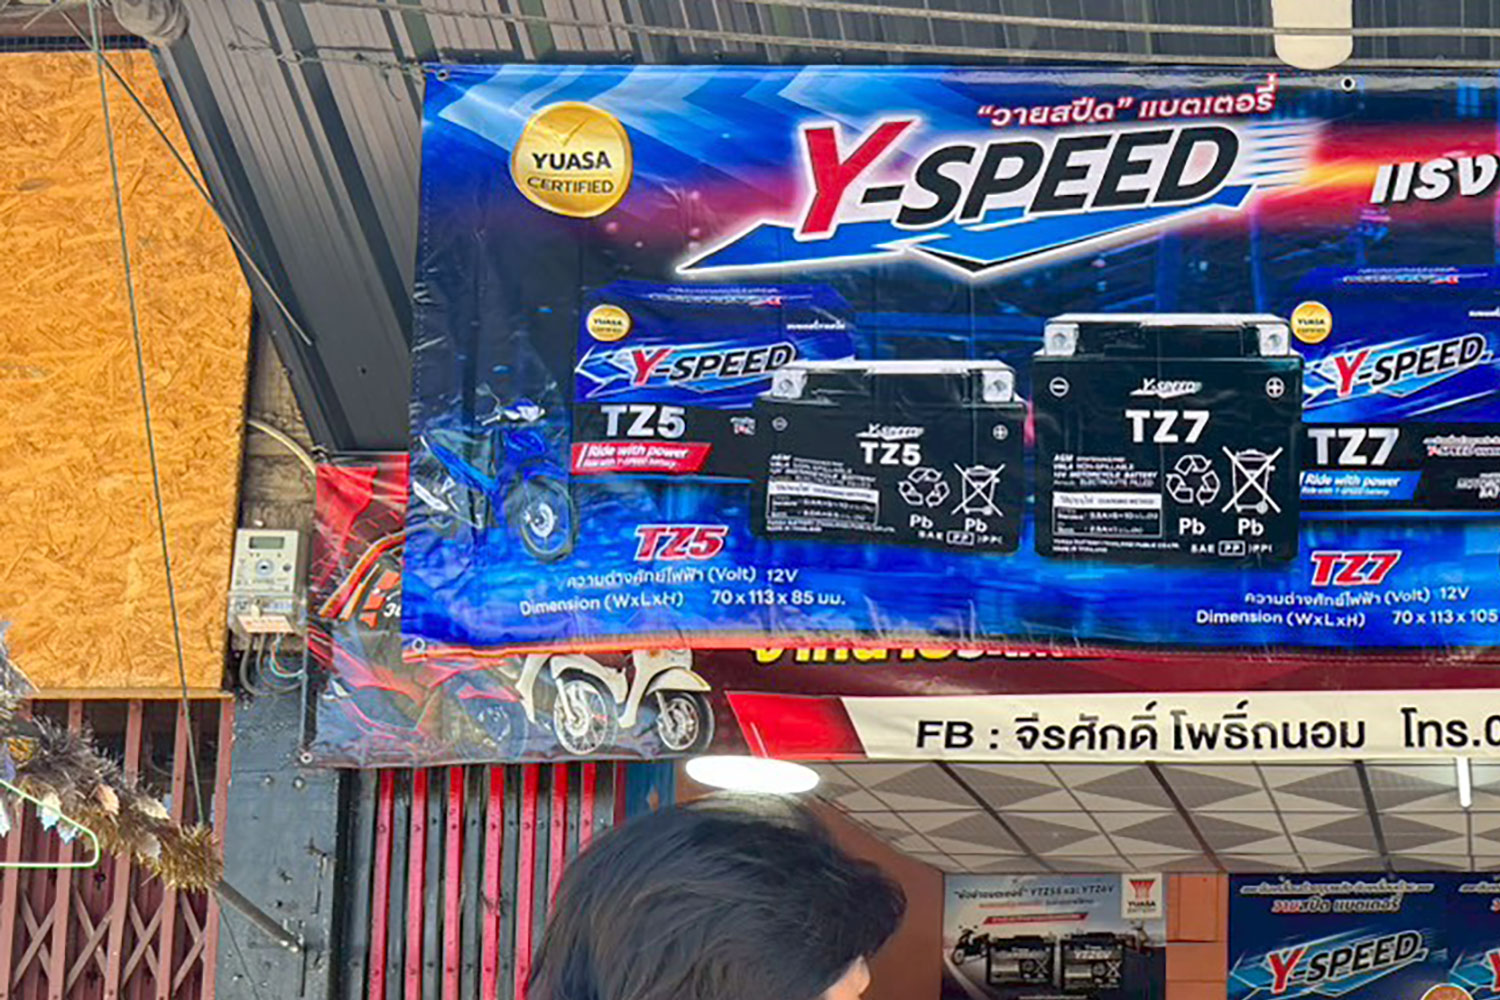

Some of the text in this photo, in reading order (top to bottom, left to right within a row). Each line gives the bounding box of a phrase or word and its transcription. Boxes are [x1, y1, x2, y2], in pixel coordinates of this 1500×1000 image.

[1139, 73, 1279, 120] แบตเตอรี่
[531, 150, 613, 171] YUASA
[527, 176, 615, 196] CERTIFIED
[801, 118, 1240, 235] Y-SPEED
[1370, 152, 1500, 204] แรง
[631, 345, 796, 387] Y-SPEED
[1334, 335, 1486, 396] Y-SPEED
[600, 404, 686, 438] TZ5
[1125, 409, 1210, 443] TZ7
[586, 444, 689, 460] Ride with power
[860, 442, 922, 466] TZ5
[1307, 427, 1400, 465] TZ7
[1305, 472, 1401, 489] Ride with power
[910, 514, 934, 529] Pb
[964, 518, 988, 533] Pb
[1179, 518, 1205, 535] Pb
[1238, 518, 1264, 536] Pb
[634, 524, 730, 562] TZ5
[708, 567, 757, 584] (Volt)
[767, 568, 798, 584] 12V
[1311, 550, 1402, 586] TZ7
[520, 597, 600, 616] Dimension
[604, 591, 684, 612] (WxLxH)
[711, 590, 733, 606] 70
[748, 590, 774, 606] 113
[789, 590, 815, 606] 85
[1384, 588, 1431, 606] (Volt)
[1440, 587, 1470, 602] 12V
[1197, 609, 1283, 626] Dimension
[1286, 610, 1365, 629] (WxLxH)
[1392, 609, 1413, 626] 70
[1429, 609, 1454, 625] 113
[1470, 609, 1498, 625] 105
[916, 720, 974, 749] FB
[1015, 702, 1157, 751] จีรศักดิ์
[1171, 700, 1365, 751] โพธิ์ถนอม
[1268, 932, 1421, 995] Y-SPEED
